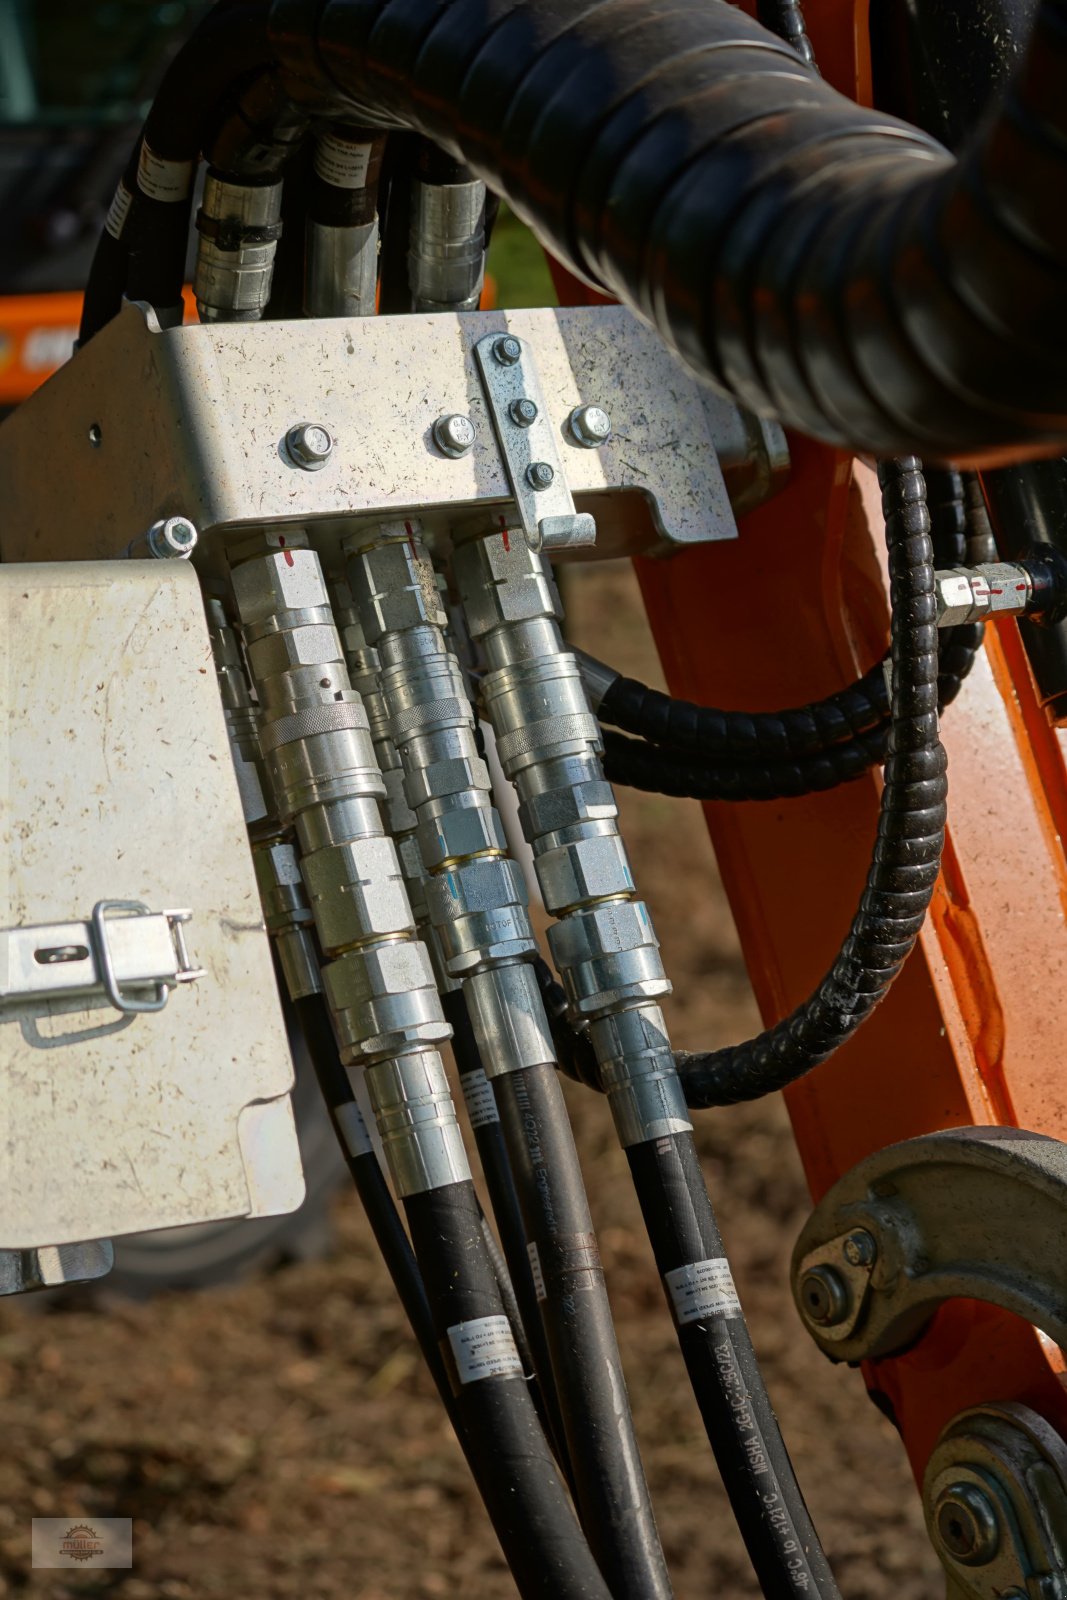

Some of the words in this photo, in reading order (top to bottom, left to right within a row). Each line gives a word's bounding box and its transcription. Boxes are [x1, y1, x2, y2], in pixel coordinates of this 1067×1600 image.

[744, 1435, 769, 1475] MSHA
[762, 1492, 790, 1536] +121°C
[783, 1540, 798, 1554] to
